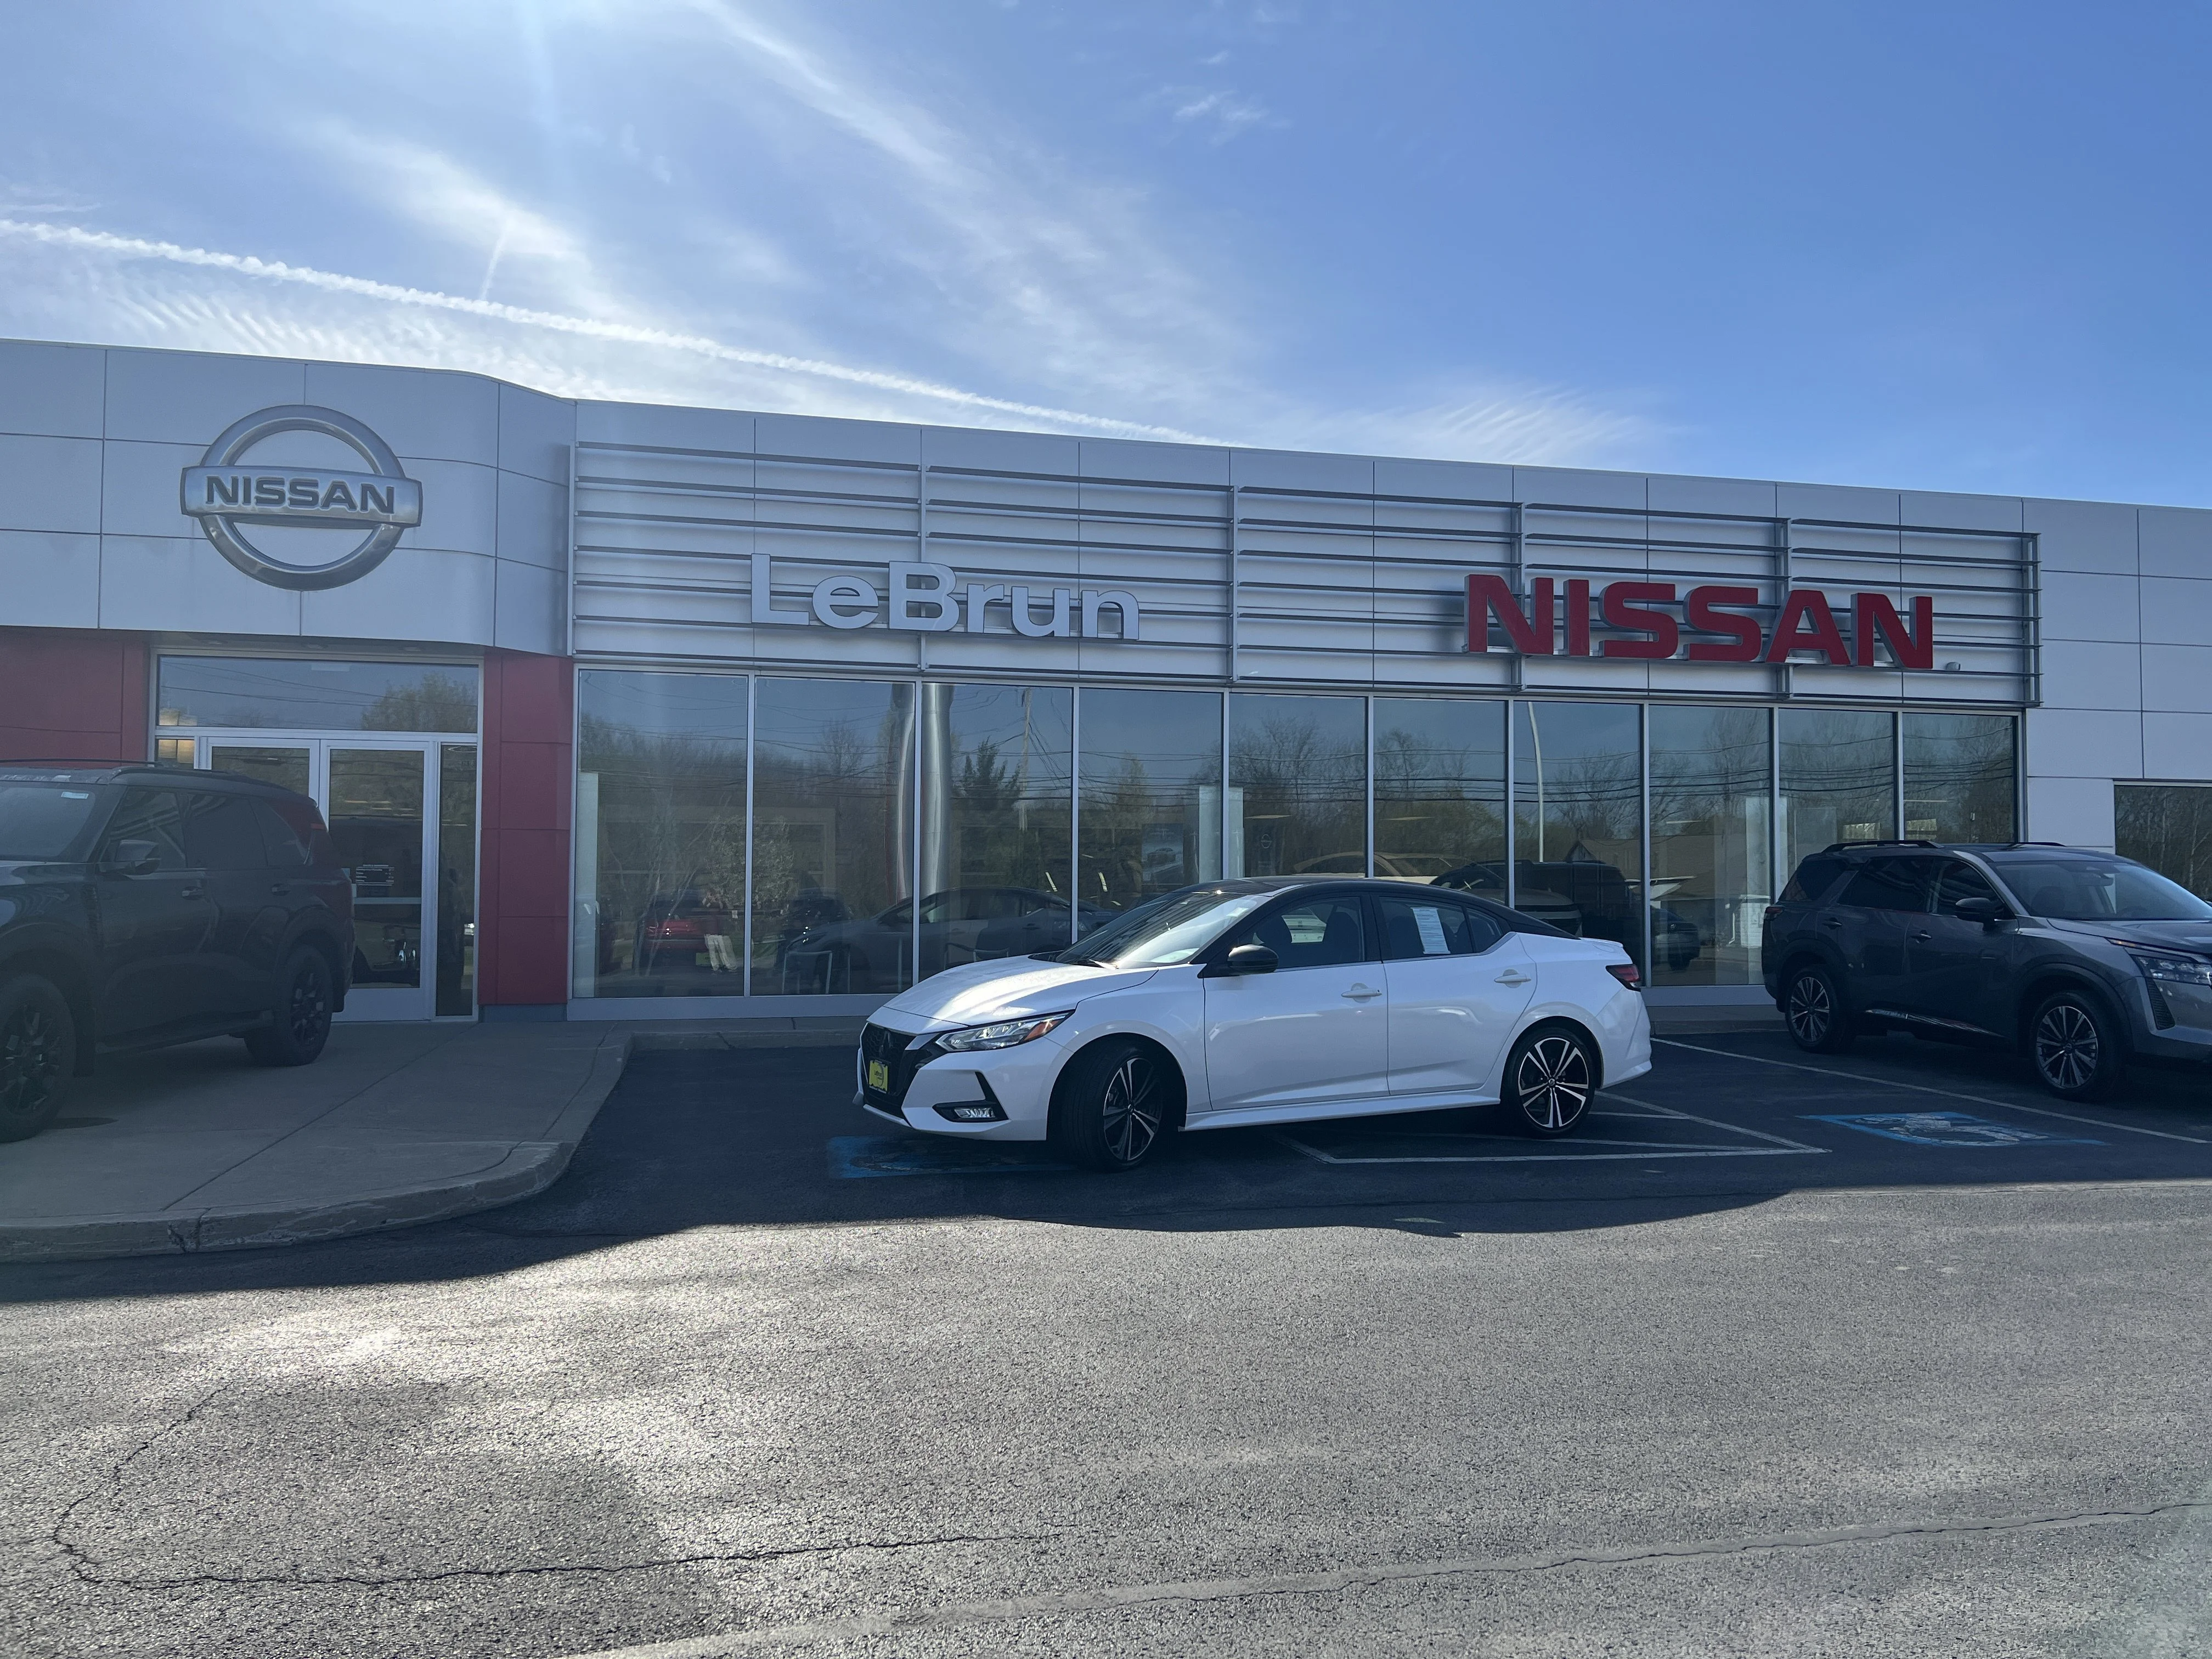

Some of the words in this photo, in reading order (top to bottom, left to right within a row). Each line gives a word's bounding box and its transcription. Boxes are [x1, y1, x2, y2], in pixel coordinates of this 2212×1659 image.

[206, 476, 394, 514] NISSAN
[751, 553, 1139, 640] LeBrun
[1464, 574, 1933, 669] NISSAN
